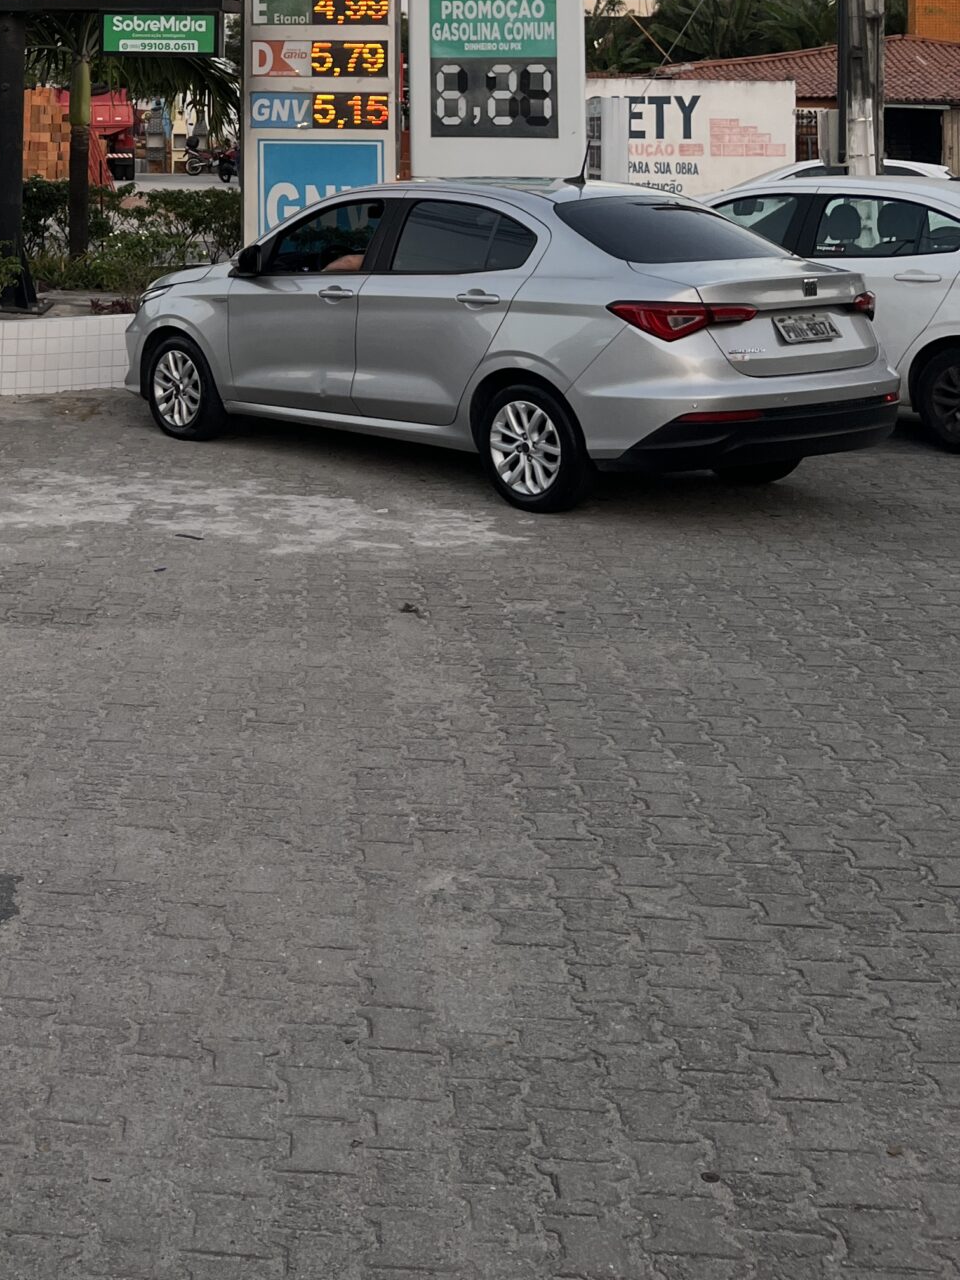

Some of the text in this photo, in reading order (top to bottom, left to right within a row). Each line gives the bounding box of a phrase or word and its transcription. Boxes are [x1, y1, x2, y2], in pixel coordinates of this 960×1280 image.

[112, 15, 207, 32] SobreMidia
[273, 11, 310, 24] Etanol
[431, 21, 555, 41] GASOLINA COMUM
[140, 42, 196, 51] 99108.0611
[464, 42, 522, 51] DINHEIRO OU PIX
[252, 41, 385, 76] D GRID 5,79
[252, 94, 389, 128] GNV 5,15
[586, 95, 702, 139] ETY
[628, 161, 700, 176] PARA SUA OBRA
